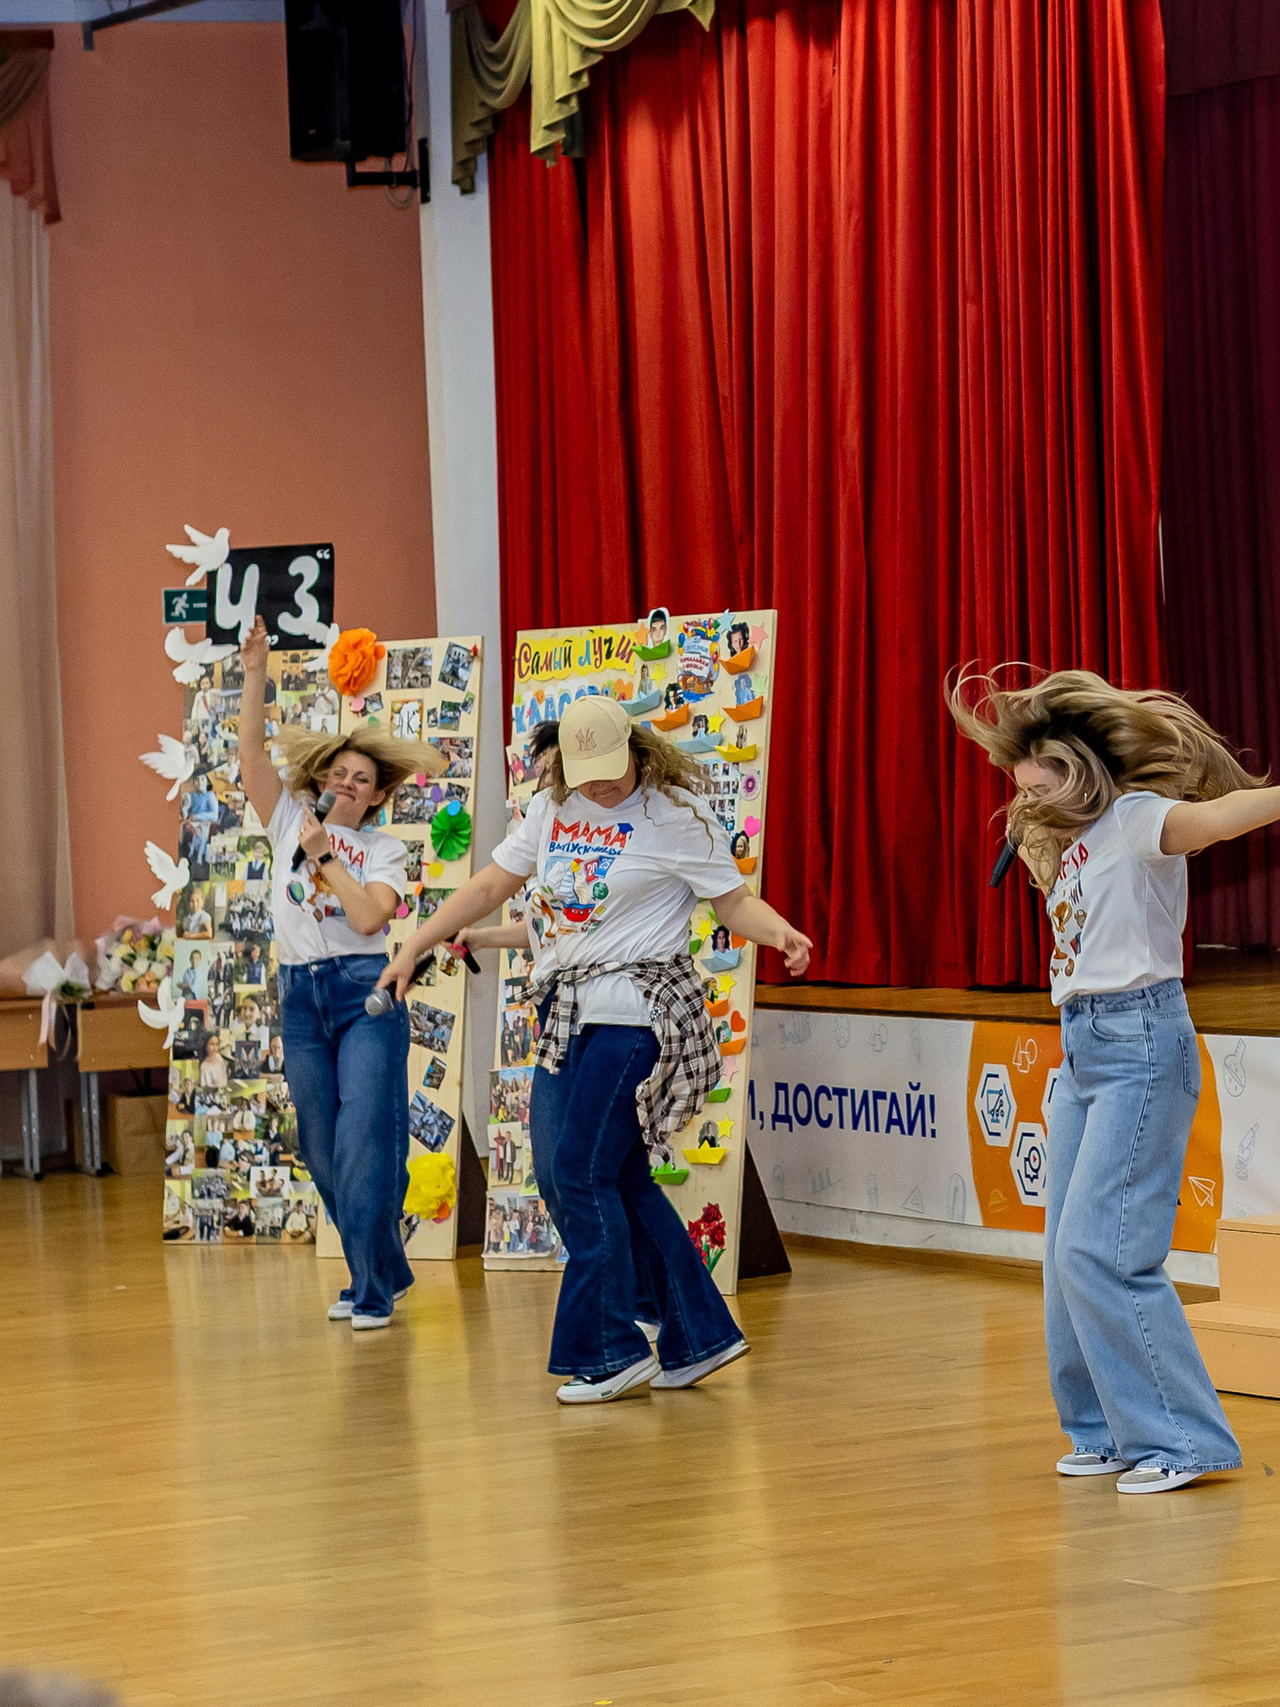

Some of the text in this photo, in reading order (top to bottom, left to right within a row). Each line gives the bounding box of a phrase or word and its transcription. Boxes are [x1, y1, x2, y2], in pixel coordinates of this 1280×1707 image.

[329, 832, 365, 868] АМА
[551, 817, 629, 848] МАМА
[771, 1081, 937, 1139] ДОСТИГАЙ!
